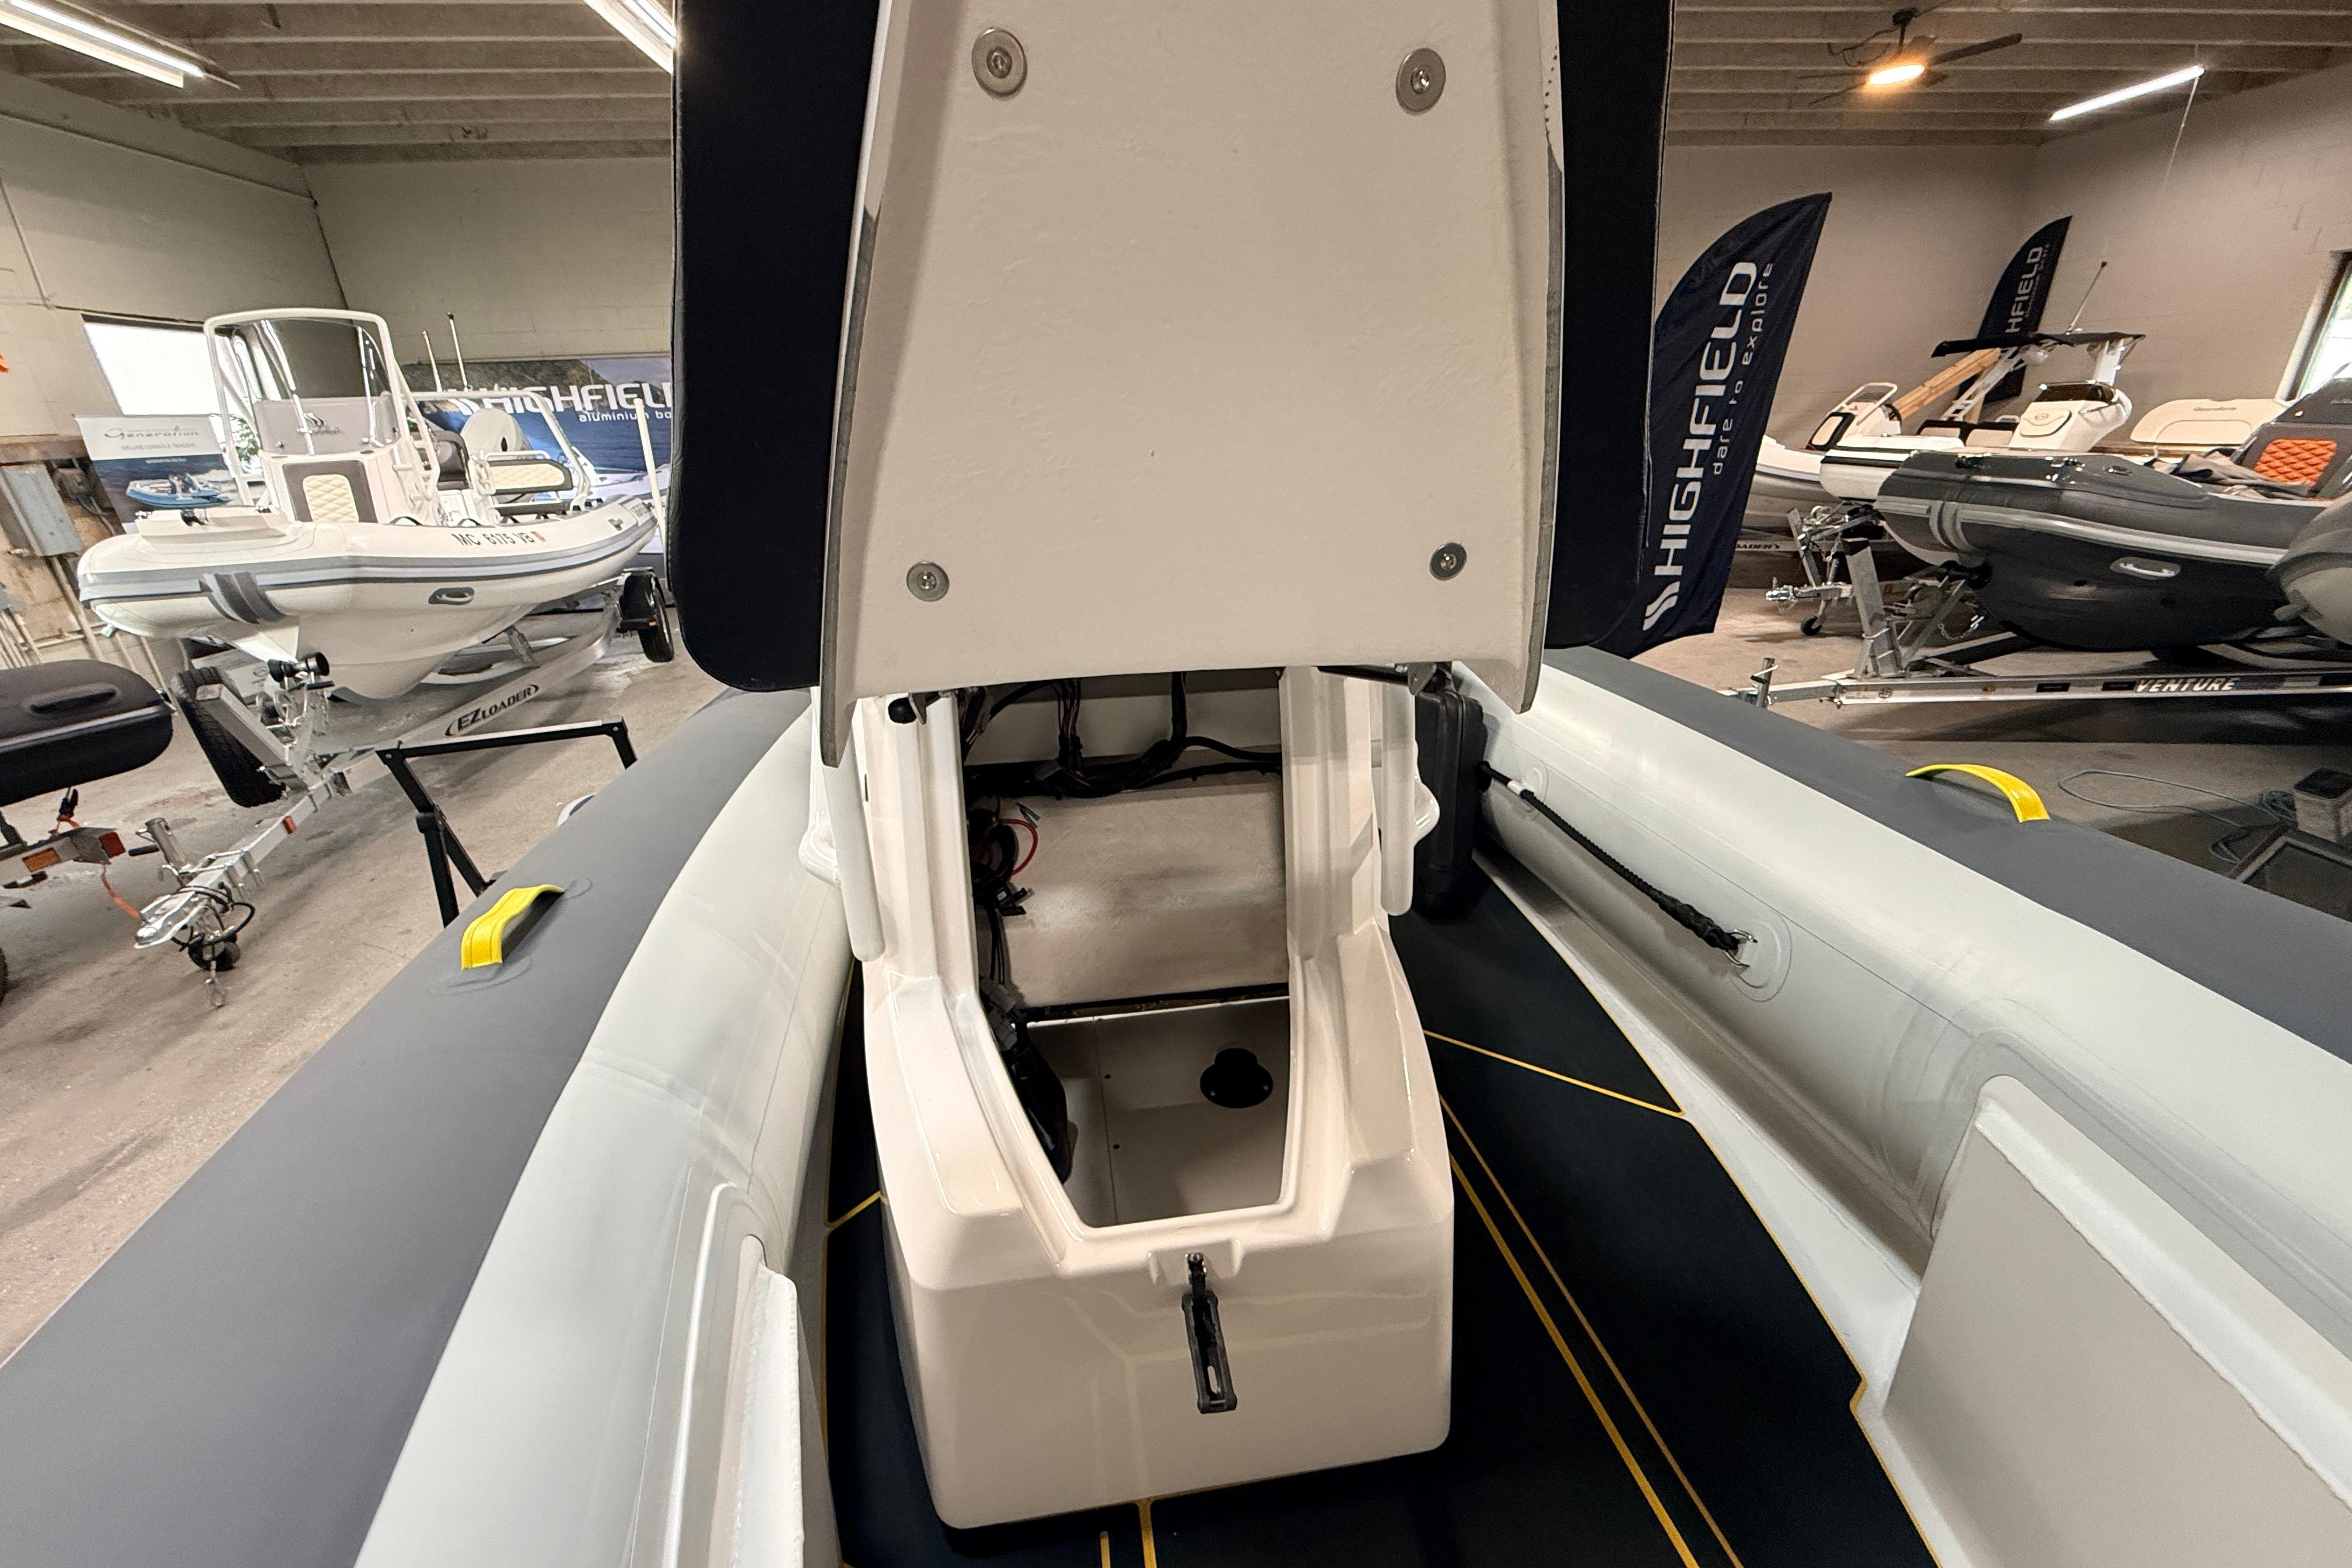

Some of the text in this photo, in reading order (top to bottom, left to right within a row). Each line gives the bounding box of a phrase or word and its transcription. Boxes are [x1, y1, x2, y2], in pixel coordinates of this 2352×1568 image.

[1713, 262, 1774, 475] dare to explore
[1654, 262, 1758, 576] HIGHFIELD
[450, 533, 481, 546] MC
[482, 533, 516, 545] 6175
[2136, 676, 2241, 692] VENTURE
[457, 686, 532, 733] EZLOADER
